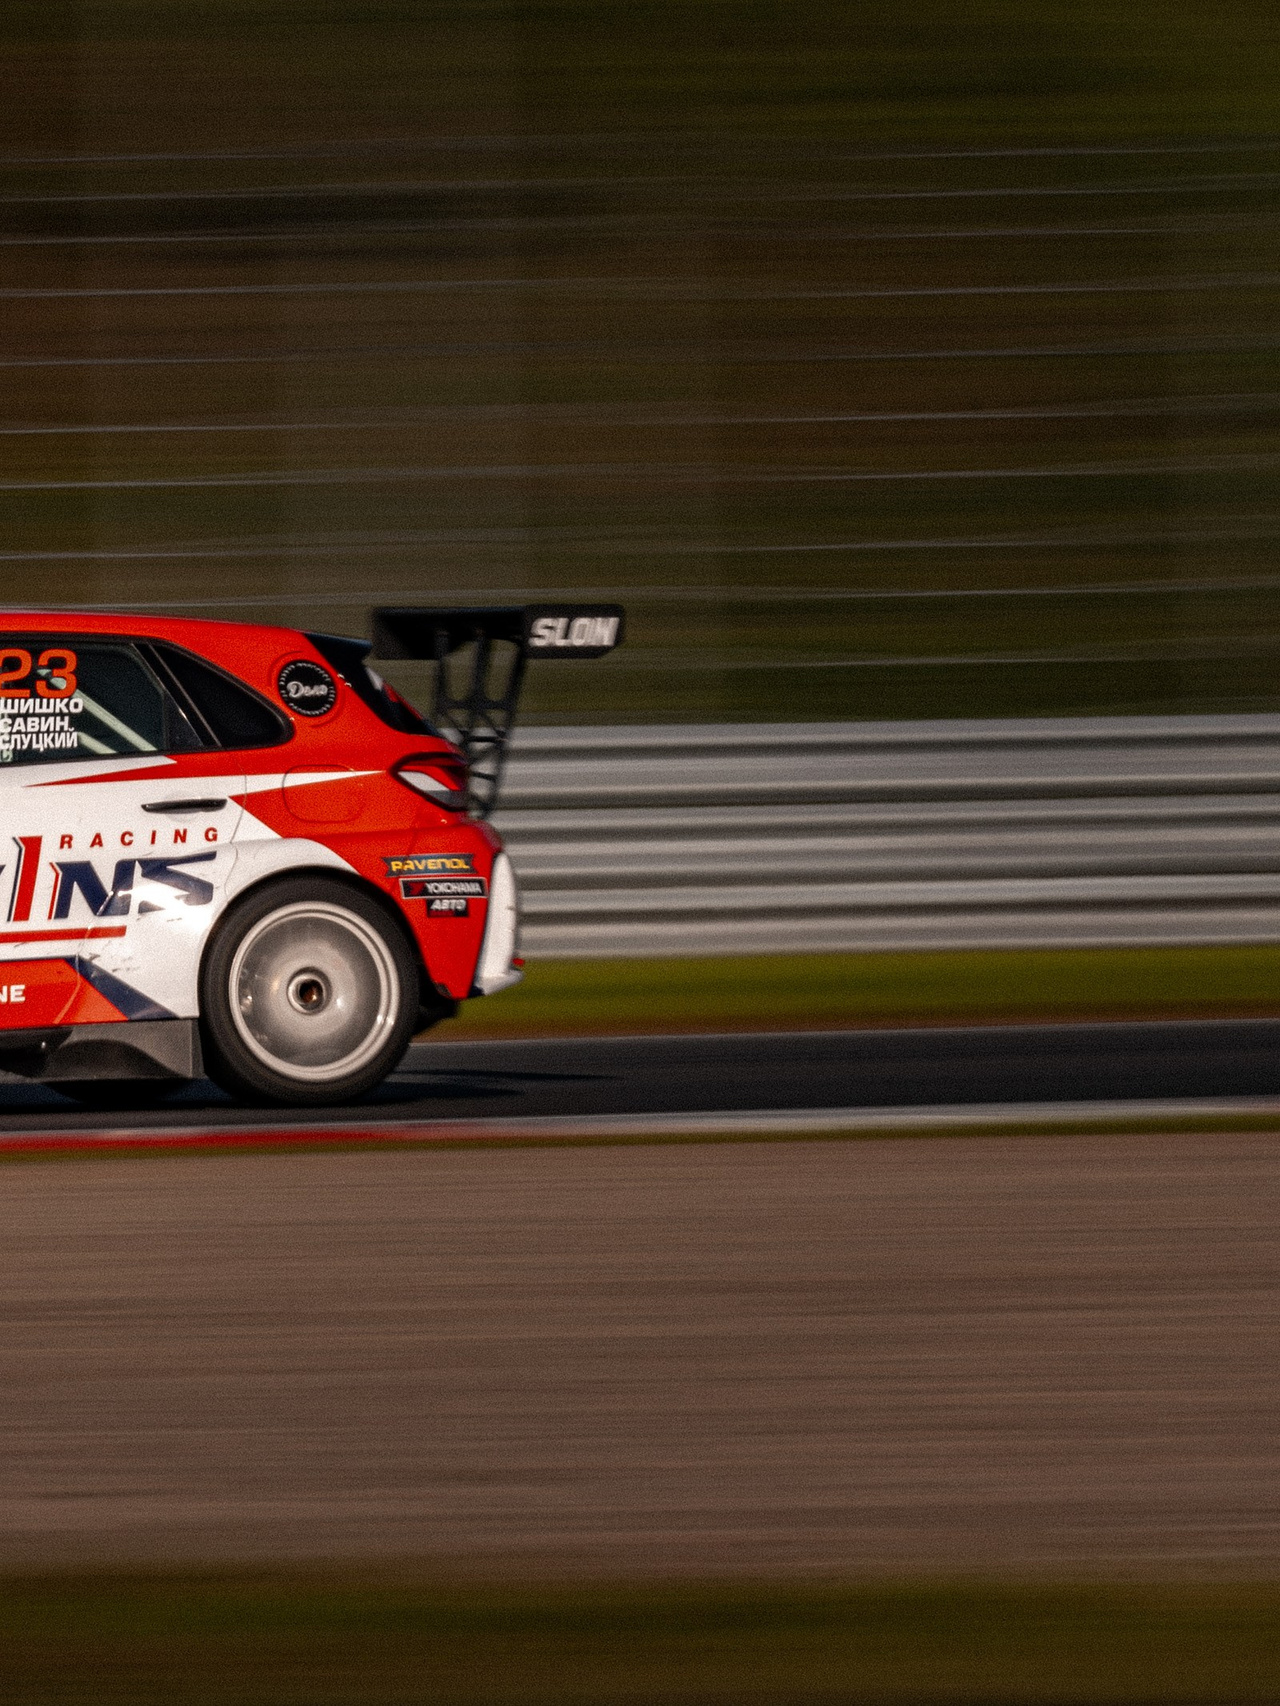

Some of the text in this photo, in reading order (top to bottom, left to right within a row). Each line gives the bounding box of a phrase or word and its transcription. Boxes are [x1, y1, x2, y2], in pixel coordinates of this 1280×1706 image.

[59, 827, 218, 849] RACING
[390, 858, 470, 872] RAVENOL
[425, 882, 483, 894] YOKOHAMA
